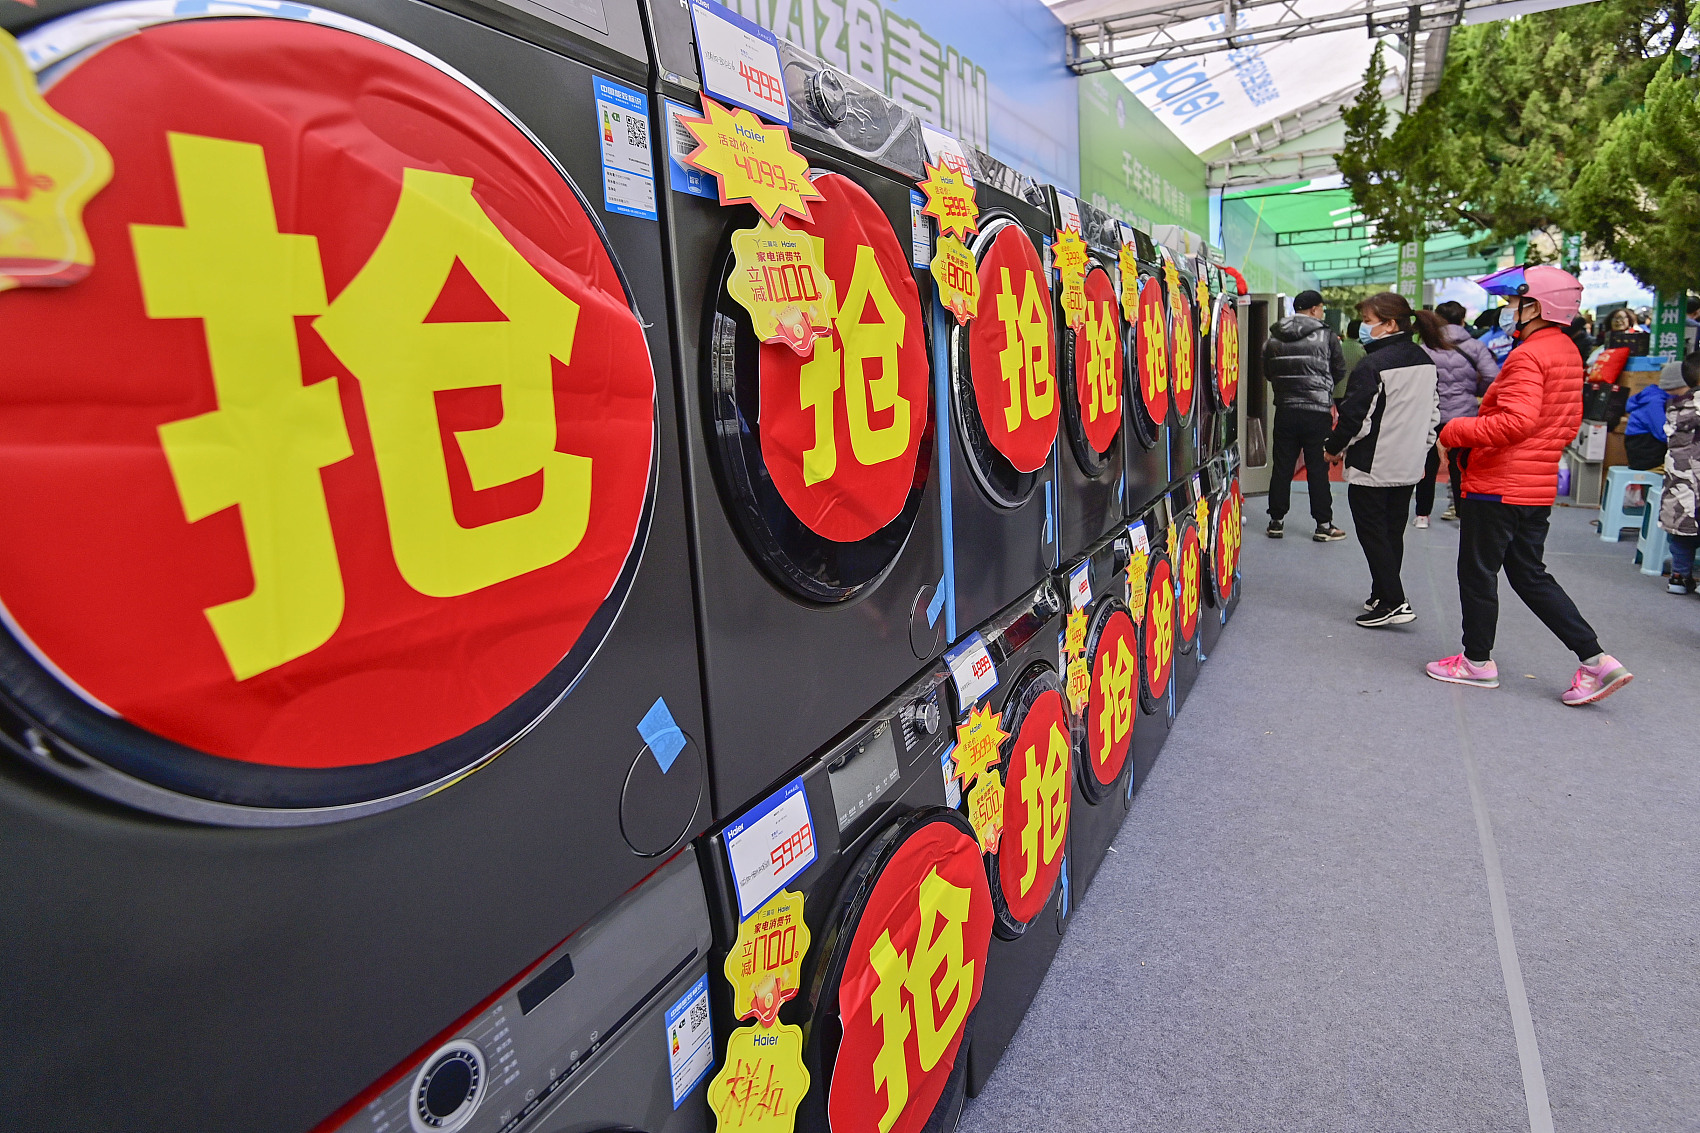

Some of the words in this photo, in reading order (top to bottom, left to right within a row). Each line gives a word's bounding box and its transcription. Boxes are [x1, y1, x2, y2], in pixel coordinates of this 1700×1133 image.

[739, 60, 784, 106] 4999
[734, 123, 765, 143] Haier
[756, 251, 802, 262] 家电消费节
[947, 261, 973, 297] 800
[996, 266, 1055, 433] 抢
[1086, 300, 1117, 423] 抢
[1143, 301, 1168, 401] 抢
[1175, 316, 1192, 394] 抢
[130, 131, 593, 681] 抢
[1182, 542, 1198, 627] 抢
[972, 655, 992, 680] 4999
[1152, 577, 1174, 683] 抢
[1100, 634, 1135, 767] 抢
[728, 823, 744, 839] Haier
[1020, 721, 1069, 898] 抢
[770, 823, 813, 876] 5999
[754, 914, 791, 935] 家电消费节
[869, 866, 975, 1133] 抢
[753, 1033, 779, 1047] Haier
